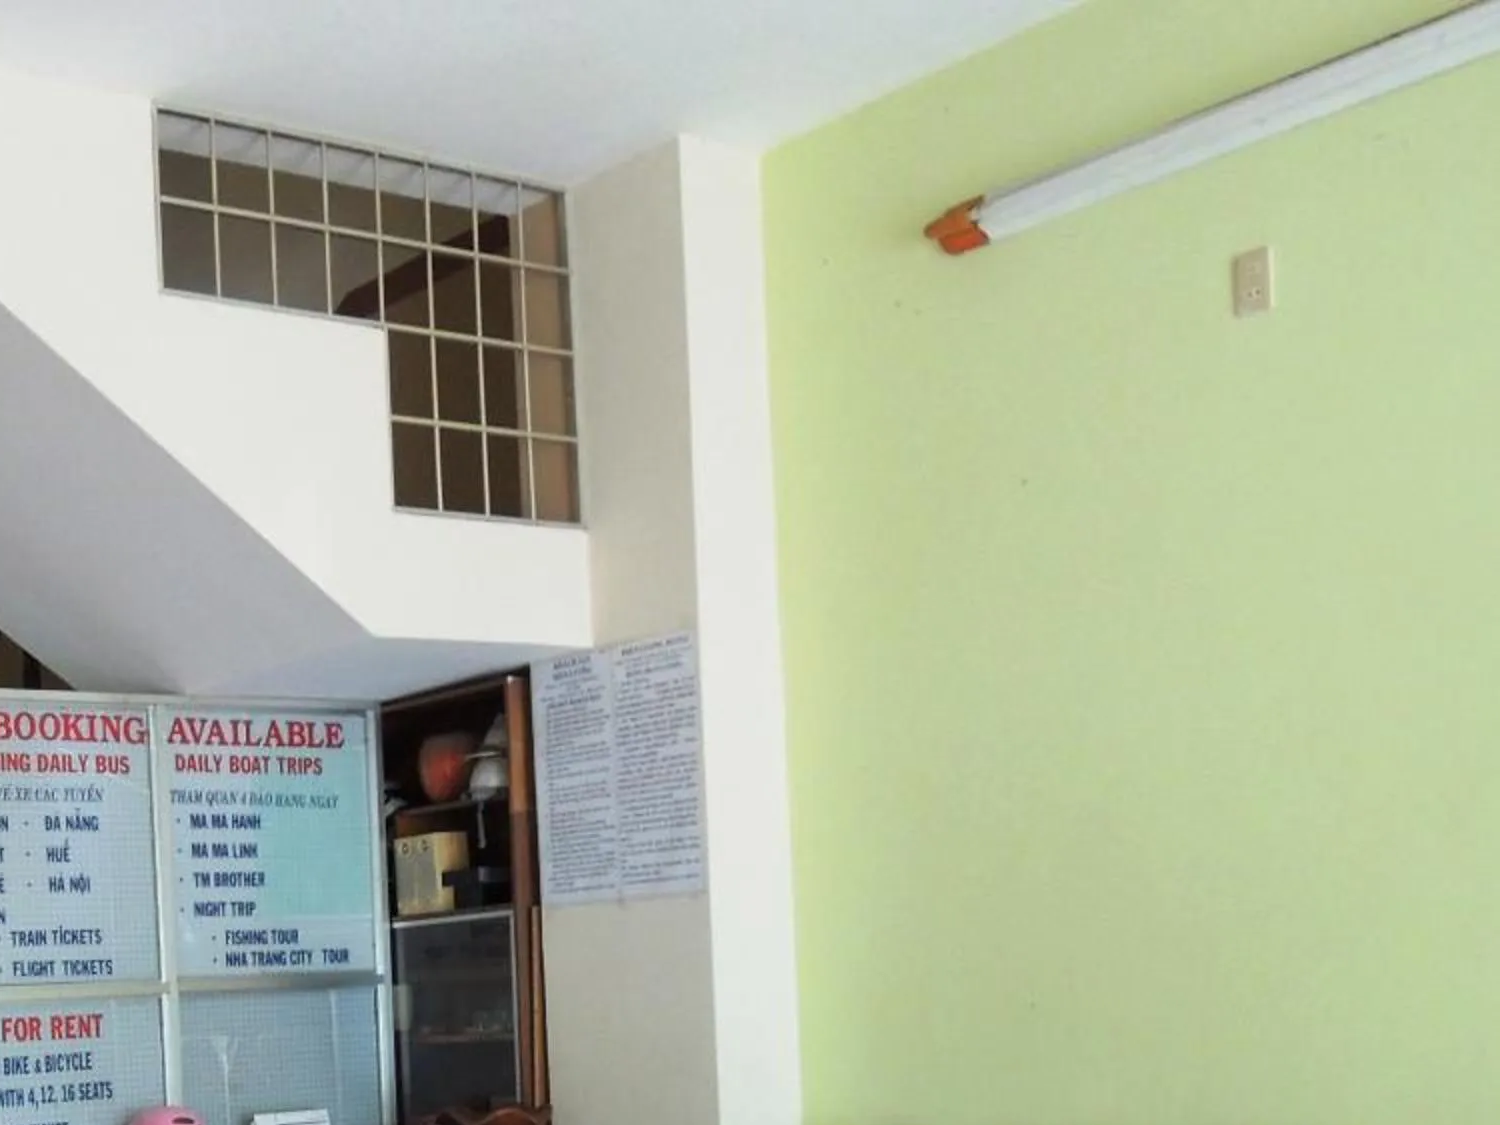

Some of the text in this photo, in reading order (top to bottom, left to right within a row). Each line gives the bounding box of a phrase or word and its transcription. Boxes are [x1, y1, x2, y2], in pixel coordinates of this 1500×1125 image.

[167, 717, 345, 748] AVAILABLE
[37, 753, 88, 774] DAILY
[96, 755, 130, 774] BUS
[175, 754, 322, 776] DAILY BOAT TRIPS
[214, 871, 265, 887] BROTHER
[194, 901, 257, 917] NIGHT TRIP
[10, 929, 47, 947] TRAIN
[225, 929, 299, 945] FISHING TOUR
[225, 948, 350, 967] NHA TRANG CITY TOUR
[12, 959, 113, 977] FLIGHT TICKETS
[1, 1013, 103, 1042] FOR RENT
[3, 1055, 31, 1076] BIKE
[44, 1052, 93, 1073] BICYCLE
[78, 1081, 114, 1102] SEATS
